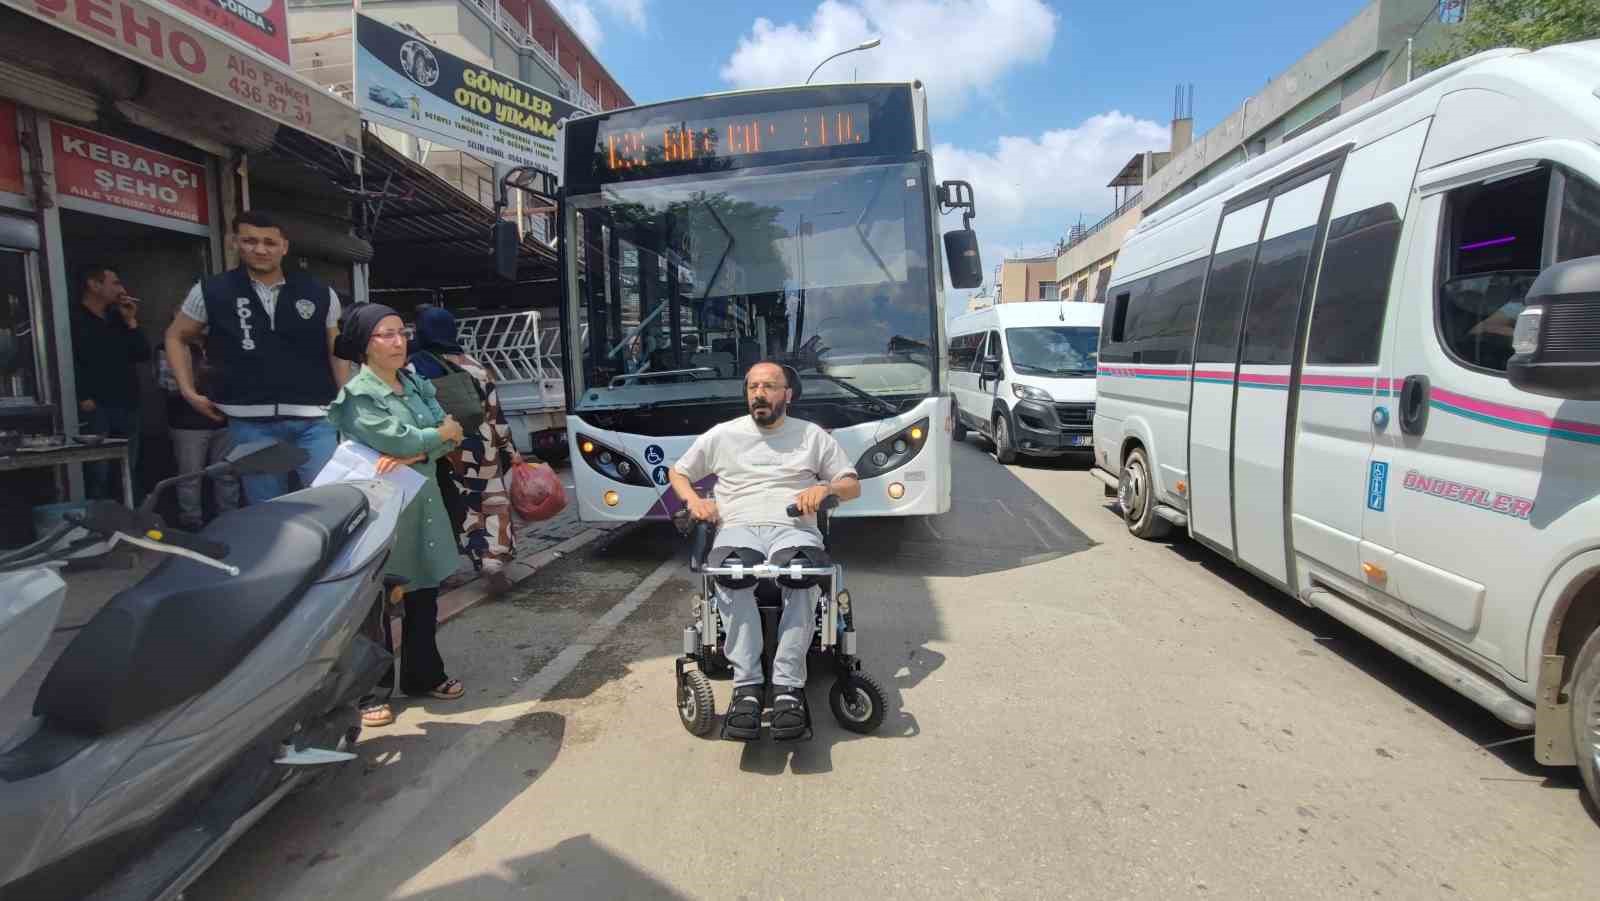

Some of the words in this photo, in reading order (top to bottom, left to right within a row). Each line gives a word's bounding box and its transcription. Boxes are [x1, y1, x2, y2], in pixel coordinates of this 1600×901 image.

[229, 78, 262, 103] 436
[454, 88, 492, 115] OTO
[495, 102, 558, 138] YIKAMA
[463, 68, 553, 118] GÖNÜLLER
[61, 135, 198, 188] KEBAPÇI
[94, 168, 179, 203] ŞEHO
[1403, 469, 1535, 520] ÖNDERLER
